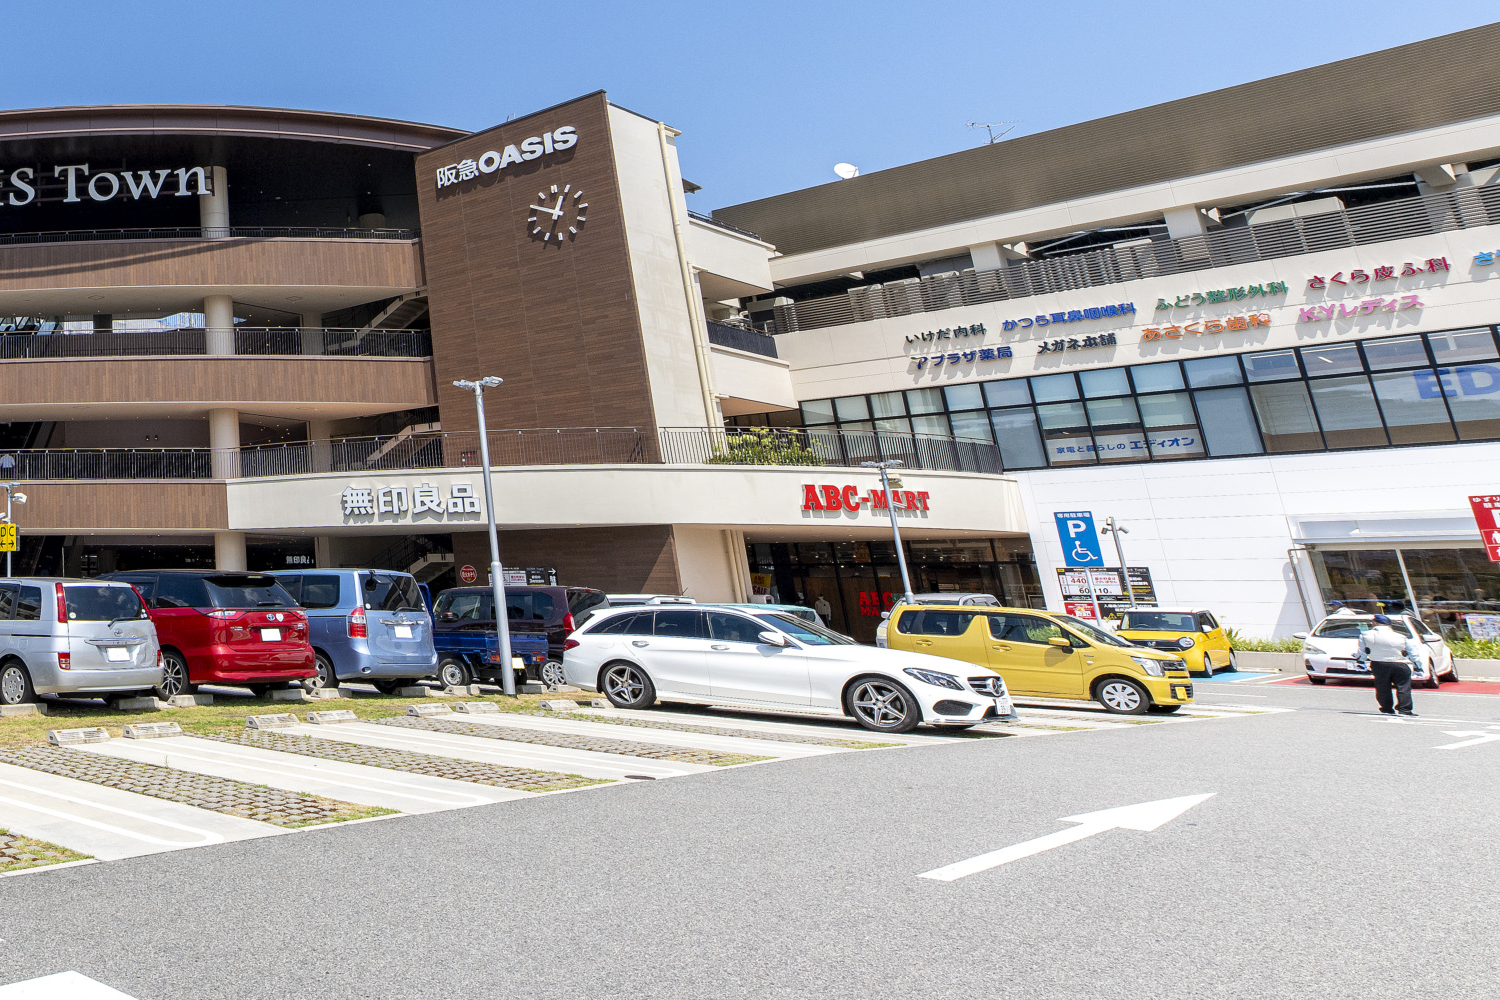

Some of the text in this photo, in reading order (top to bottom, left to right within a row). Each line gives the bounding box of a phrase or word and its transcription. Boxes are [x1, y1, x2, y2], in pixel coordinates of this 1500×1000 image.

[436, 126, 578, 188] 阪急OASIS
[54, 163, 211, 203] Town
[1473, 249, 1500, 266] さ
[1307, 257, 1450, 289] さくら皮ふ科
[1155, 280, 1288, 310] ふどう整形外科
[1300, 295, 1424, 322] KYレディス
[1002, 302, 1137, 331] かつら耳鼻咽喉科
[1142, 313, 1271, 341] あさくら歯科
[905, 323, 987, 344] いけだ内科
[1037, 332, 1117, 355] メガネ本舗
[342, 483, 481, 515] 無印良品
[802, 484, 930, 511] ABC-MART
[1, 526, 7, 537] D
[9, 526, 14, 536] C
[1067, 520, 1086, 538] P
